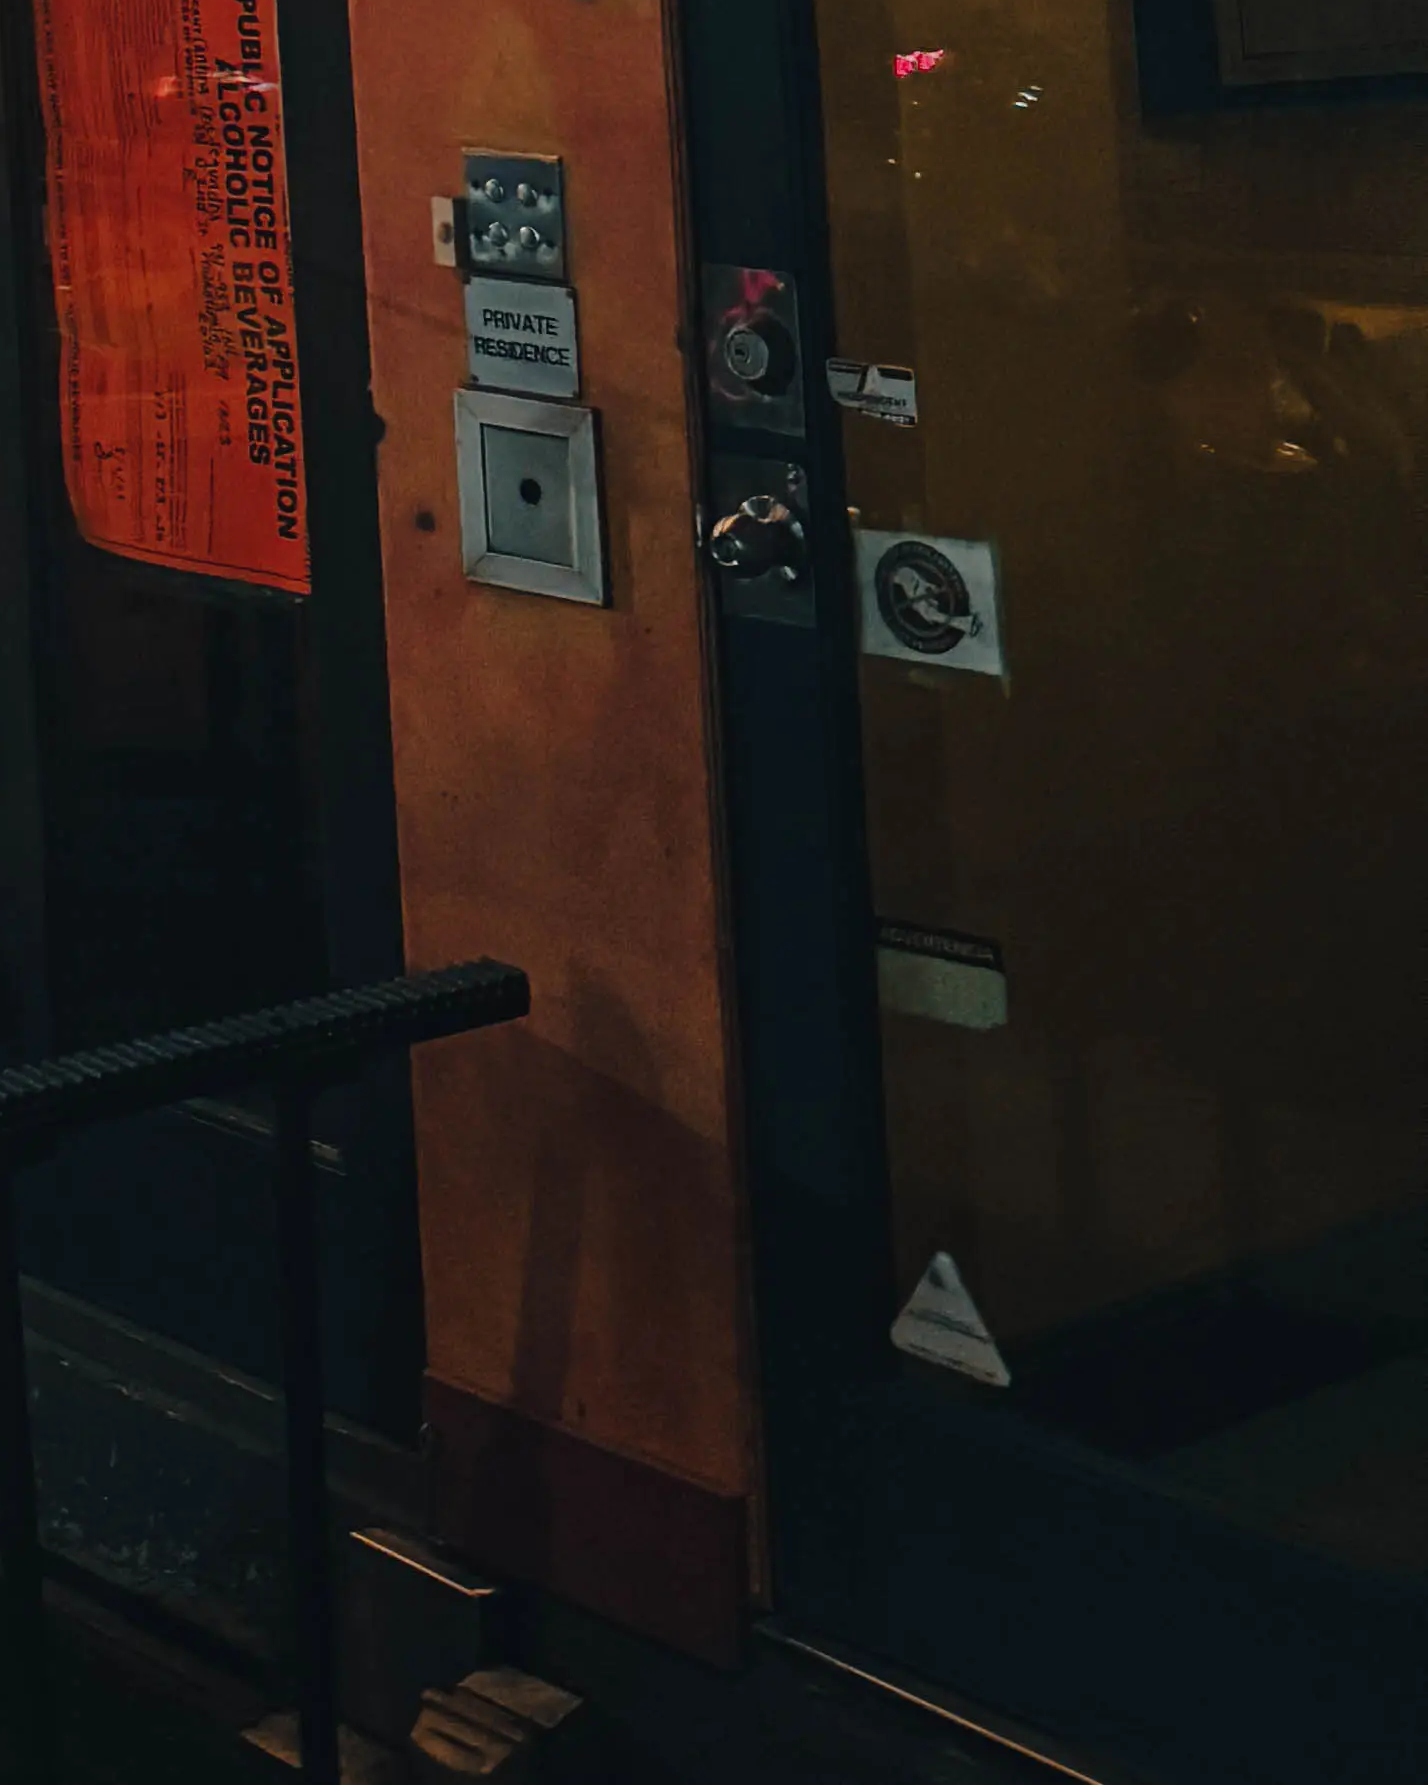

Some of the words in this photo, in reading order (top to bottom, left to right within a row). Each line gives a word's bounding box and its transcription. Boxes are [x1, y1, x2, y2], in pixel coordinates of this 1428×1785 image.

[215, 57, 250, 248] ALCOHOLIC
[246, 126, 278, 251] NOTICE
[257, 260, 283, 305] OF
[482, 308, 560, 336] PRIVATE
[231, 260, 271, 466] BEVERAGES
[473, 335, 571, 367] RESIDENCE
[262, 314, 299, 541] APPLICATION
